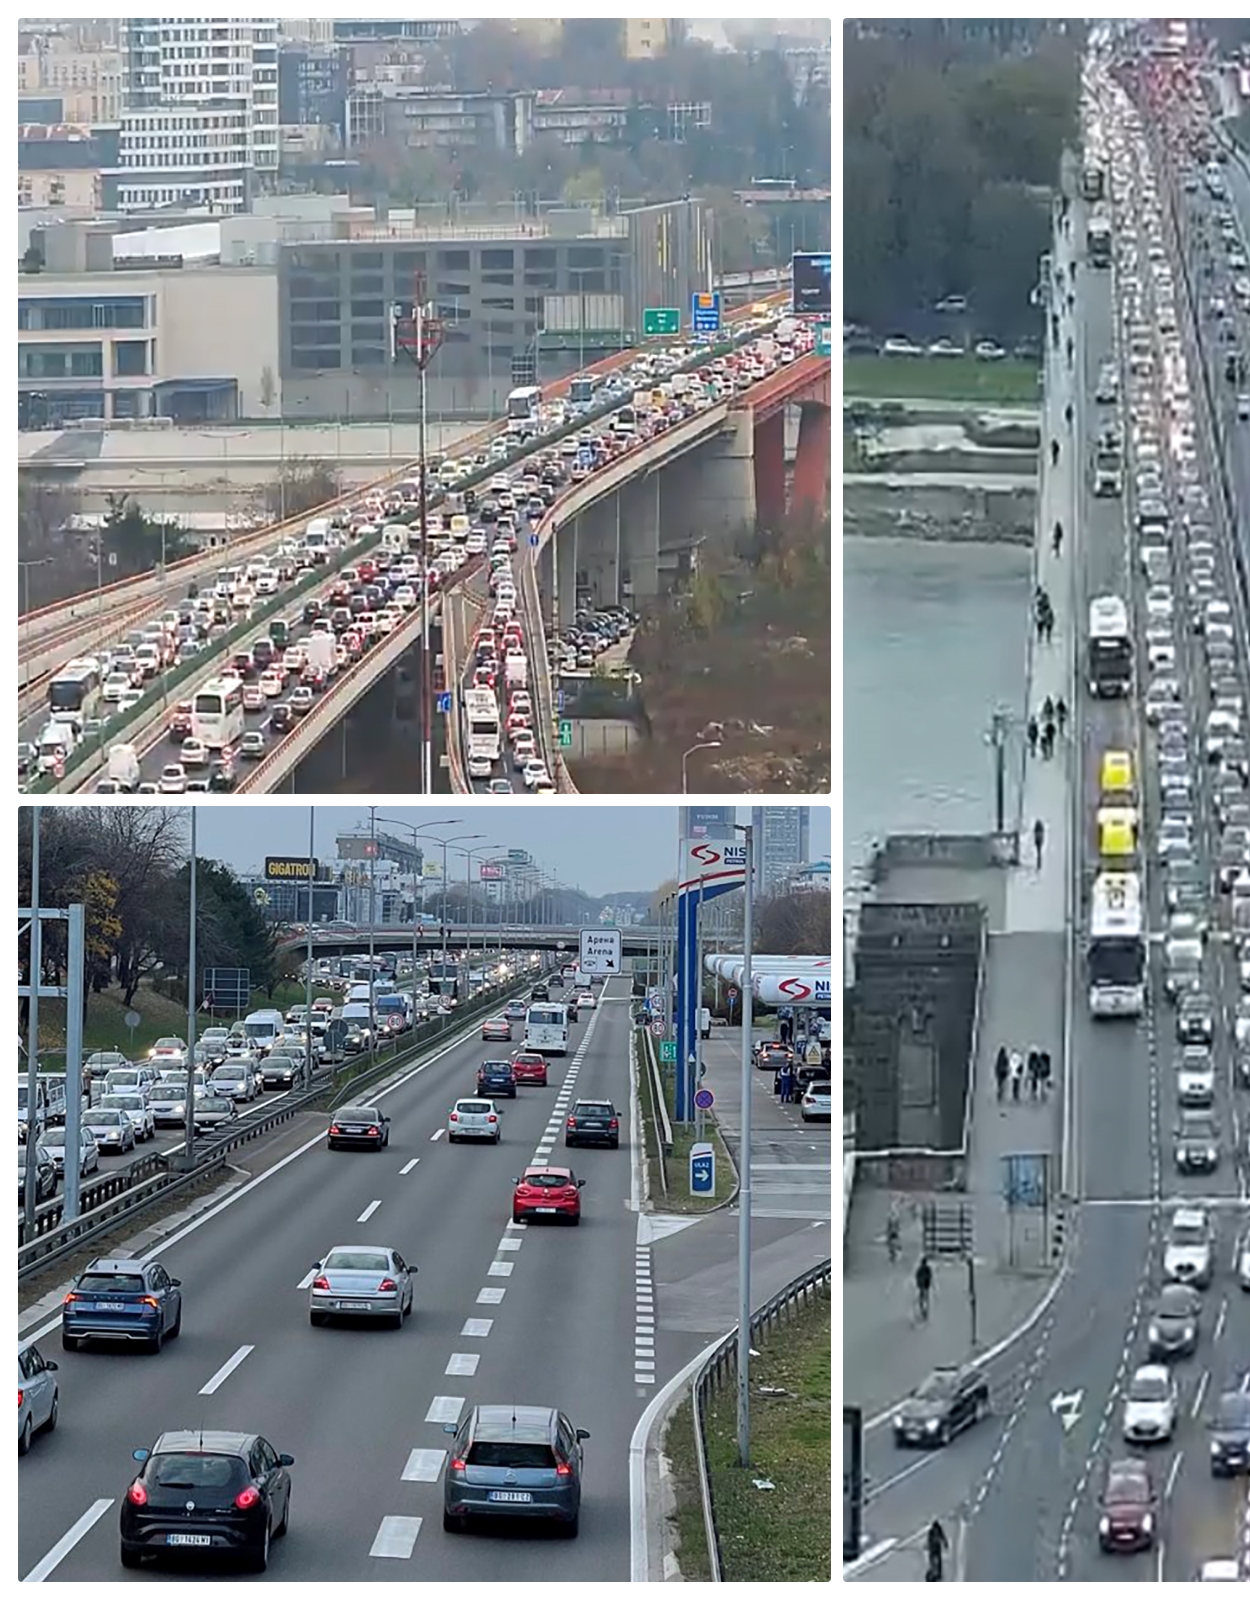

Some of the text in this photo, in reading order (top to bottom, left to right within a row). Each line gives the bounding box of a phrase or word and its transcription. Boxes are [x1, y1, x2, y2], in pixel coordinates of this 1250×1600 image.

[724, 847, 747, 857] NIS
[587, 936, 615, 945] Арена
[587, 947, 613, 955] Arena
[815, 981, 831, 991] NI
